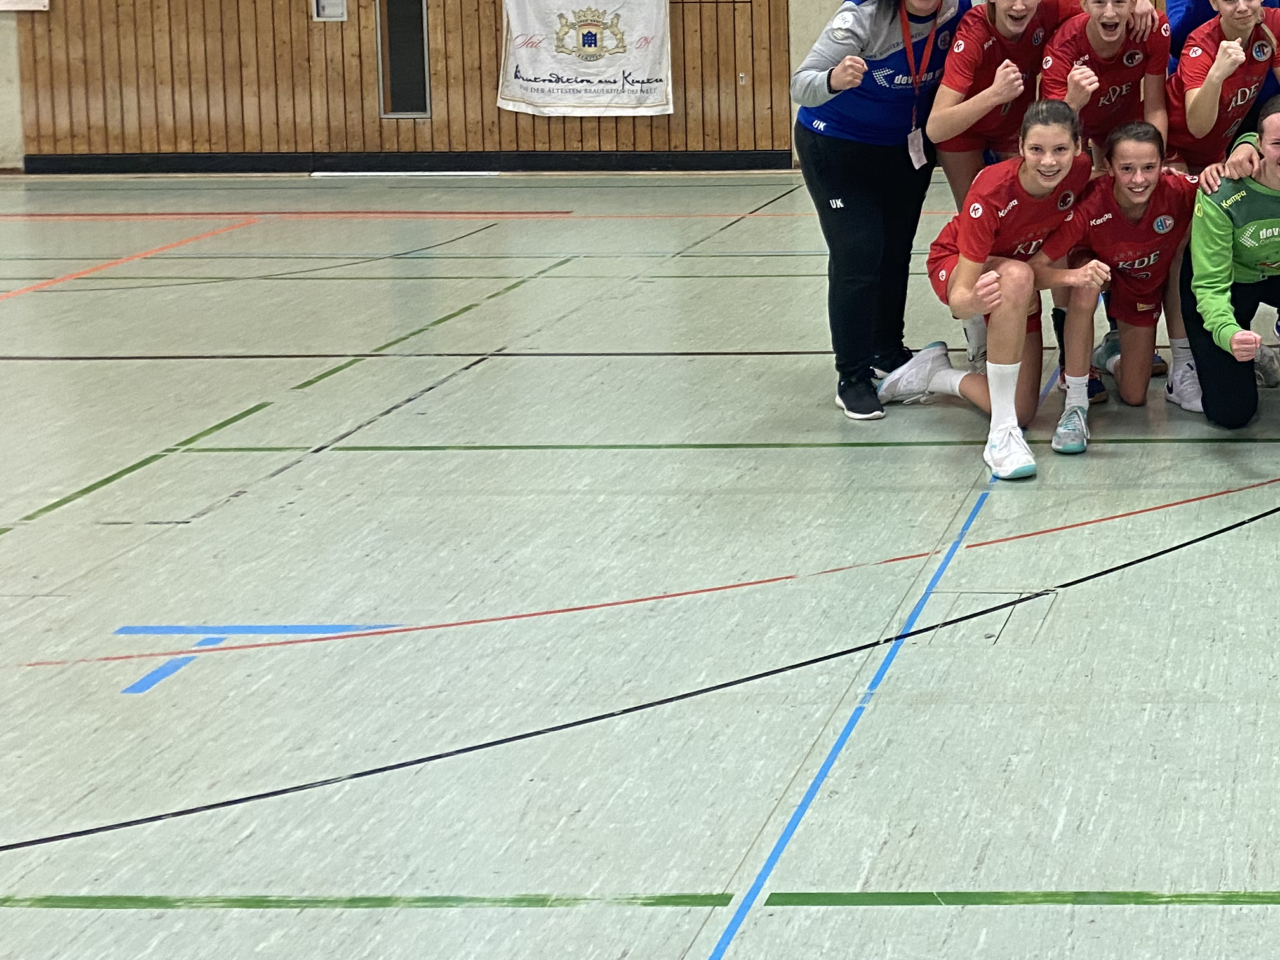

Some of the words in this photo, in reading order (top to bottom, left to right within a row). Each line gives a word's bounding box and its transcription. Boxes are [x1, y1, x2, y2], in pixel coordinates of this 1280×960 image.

[812, 119, 826, 132] UK
[829, 198, 844, 209] UK
[1118, 250, 1160, 269] KDE
